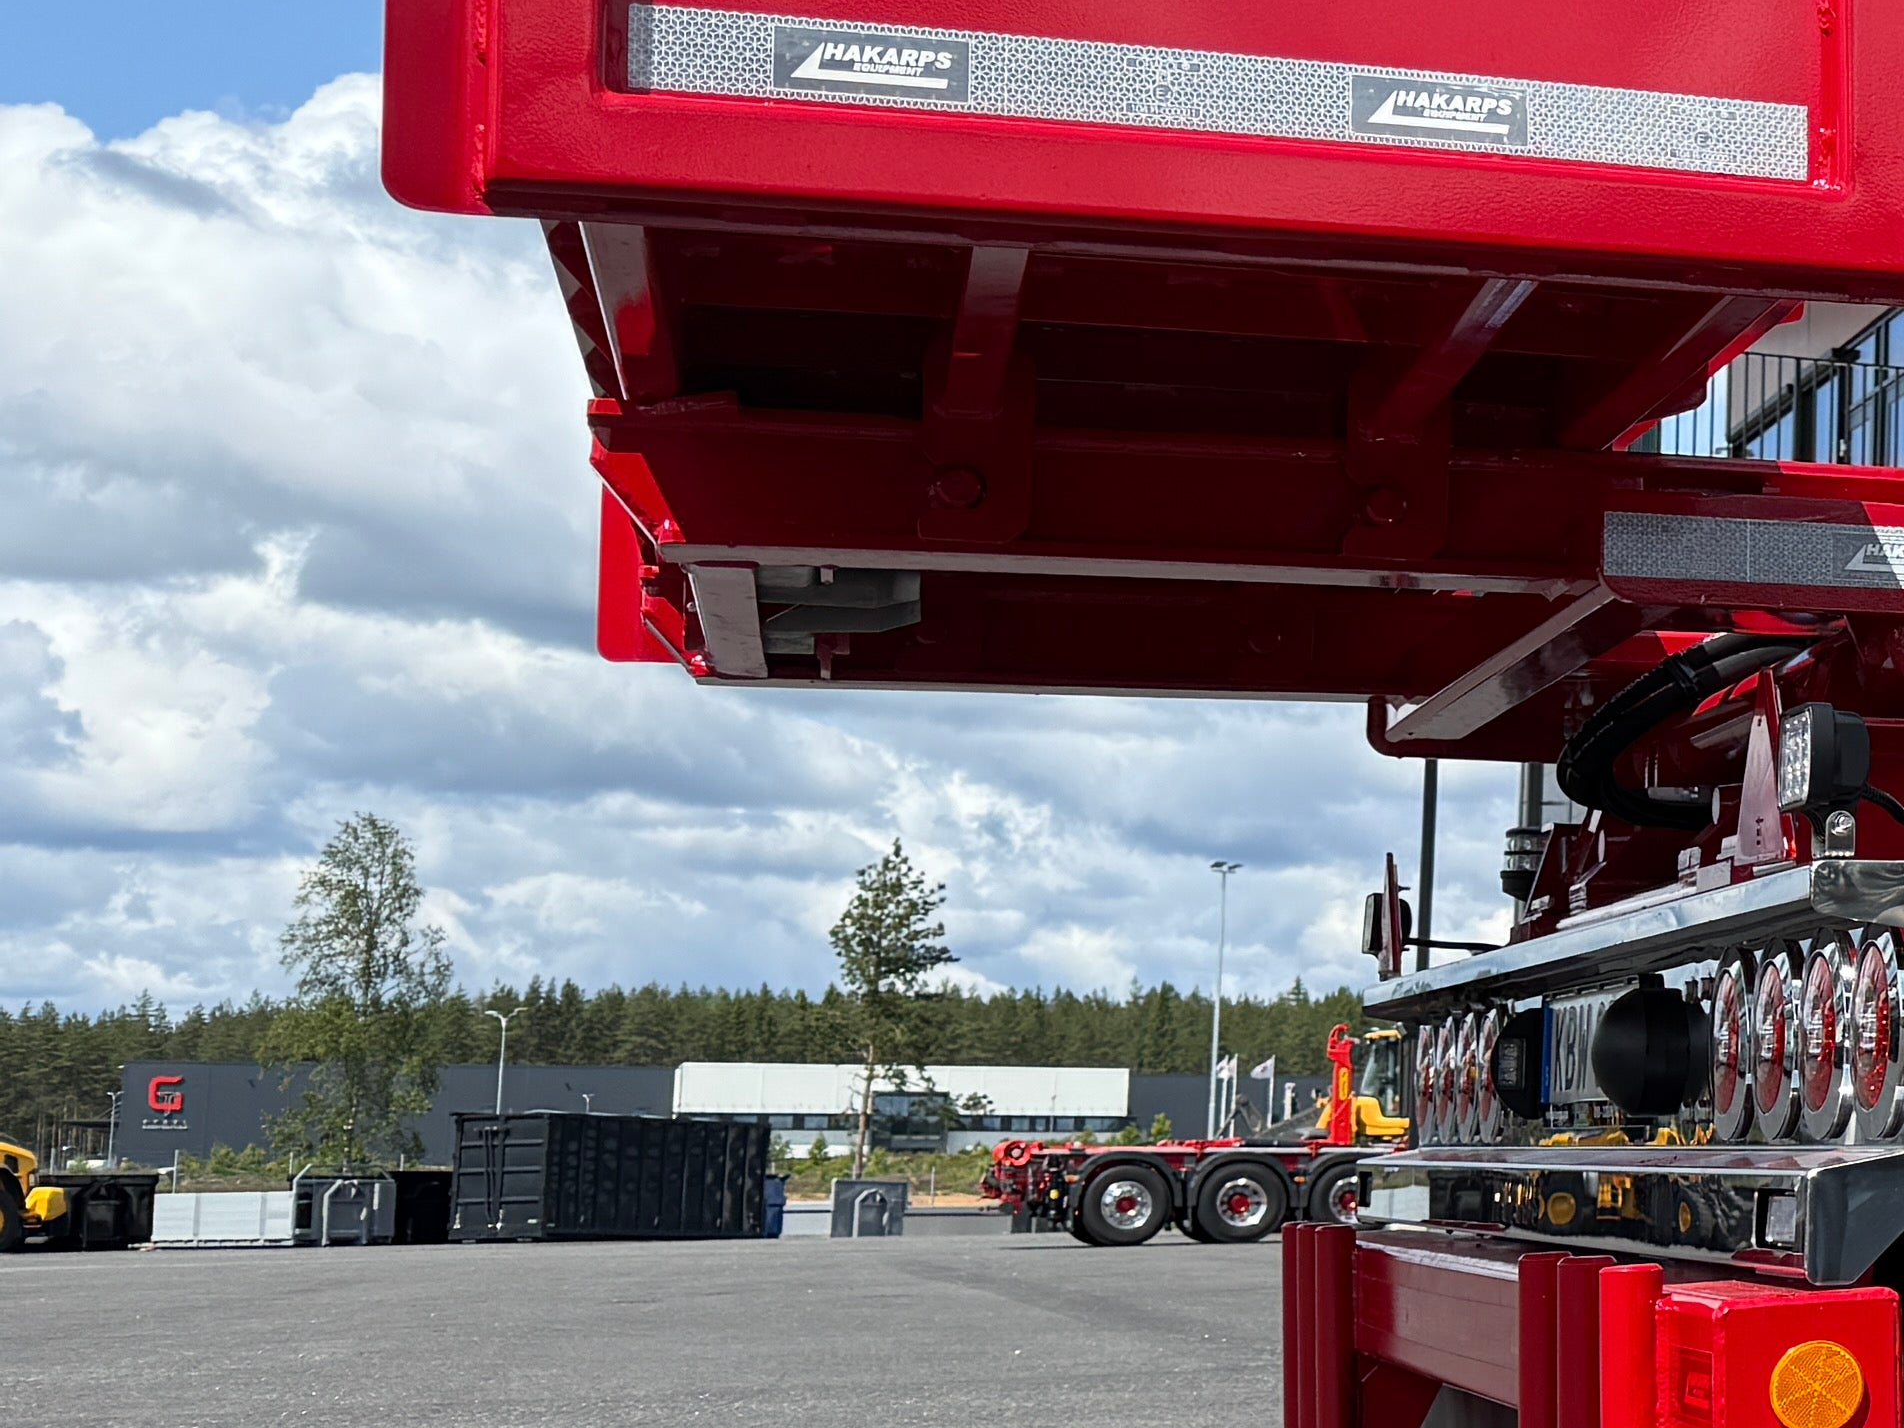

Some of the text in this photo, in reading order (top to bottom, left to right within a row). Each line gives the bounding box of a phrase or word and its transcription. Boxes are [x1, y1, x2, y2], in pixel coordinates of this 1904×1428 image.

[823, 42, 953, 69] HAKARPS
[853, 62, 925, 77] EQUIPMENT
[1396, 90, 1513, 115] HAKARPS
